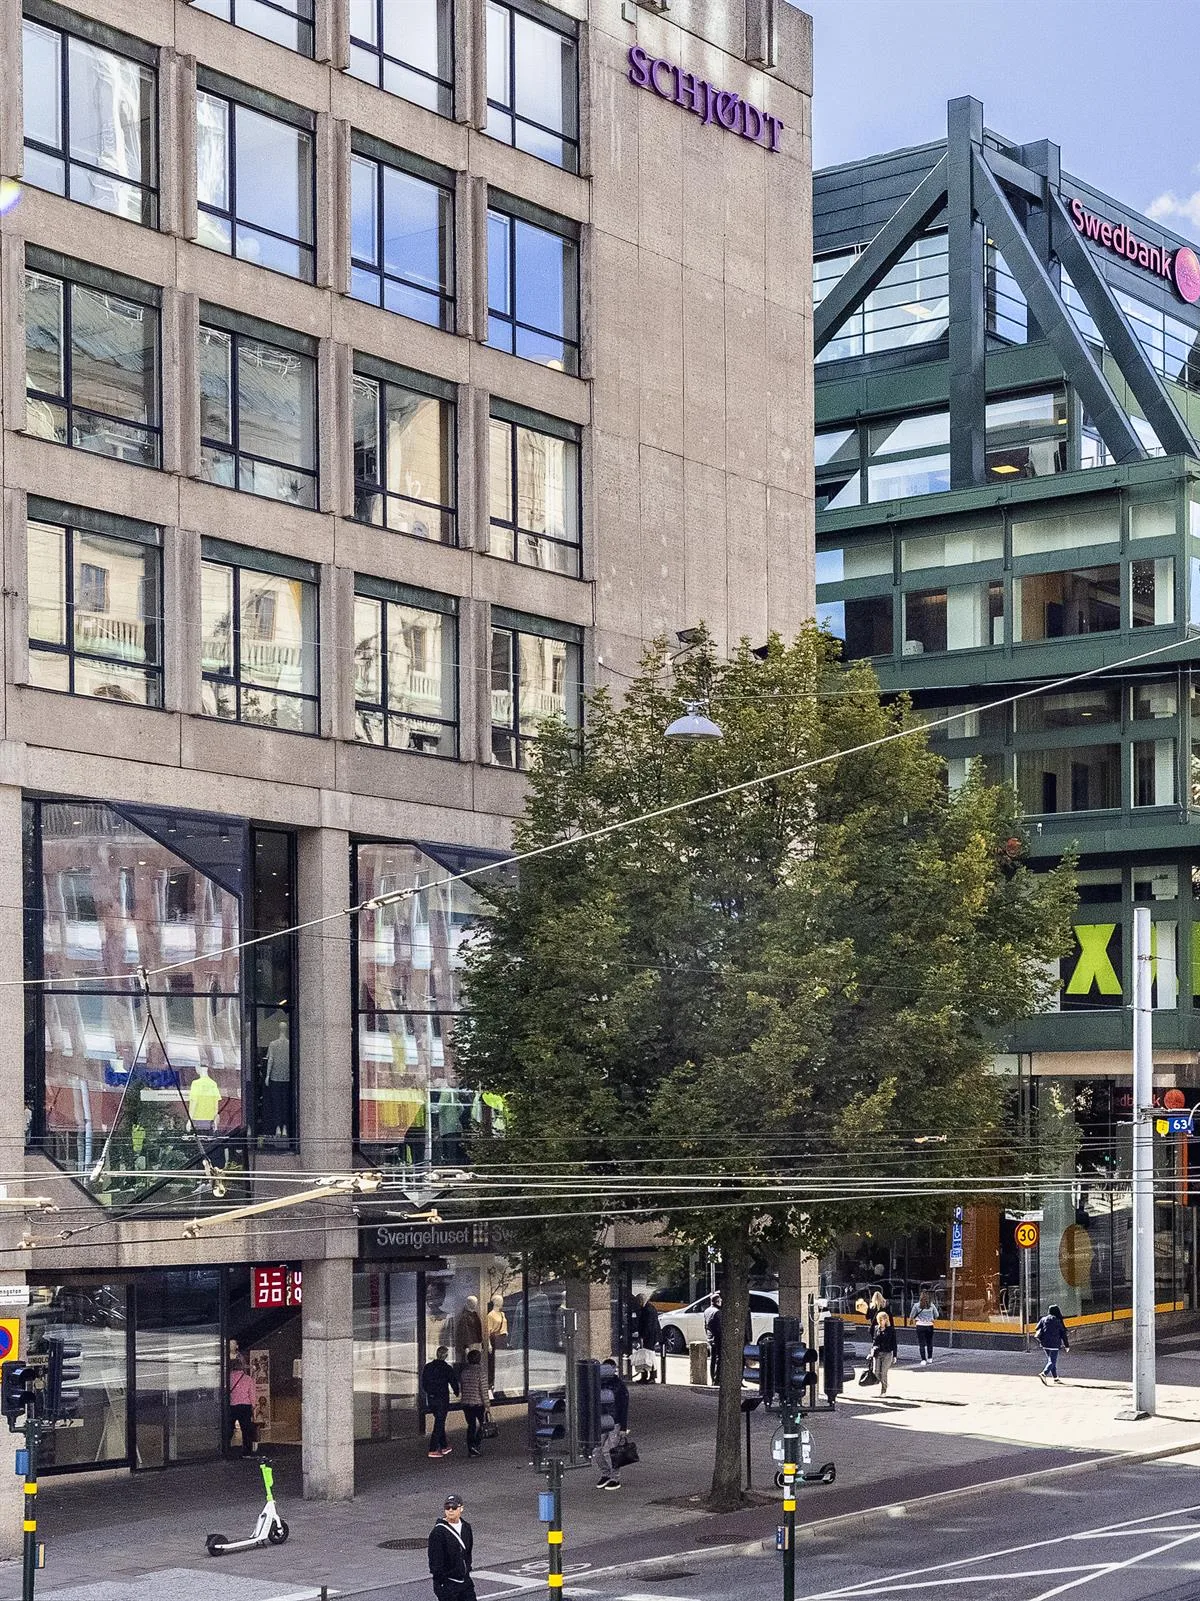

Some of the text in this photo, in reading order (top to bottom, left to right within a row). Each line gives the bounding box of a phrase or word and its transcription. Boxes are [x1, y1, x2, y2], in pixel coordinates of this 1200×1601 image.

[628, 46, 784, 153] SCHJØDT
[1071, 199, 1172, 281] Swedbank
[1173, 1119, 1188, 1130] 63
[376, 1226, 469, 1249] Sverigehuset
[1019, 1229, 1036, 1242] 30
